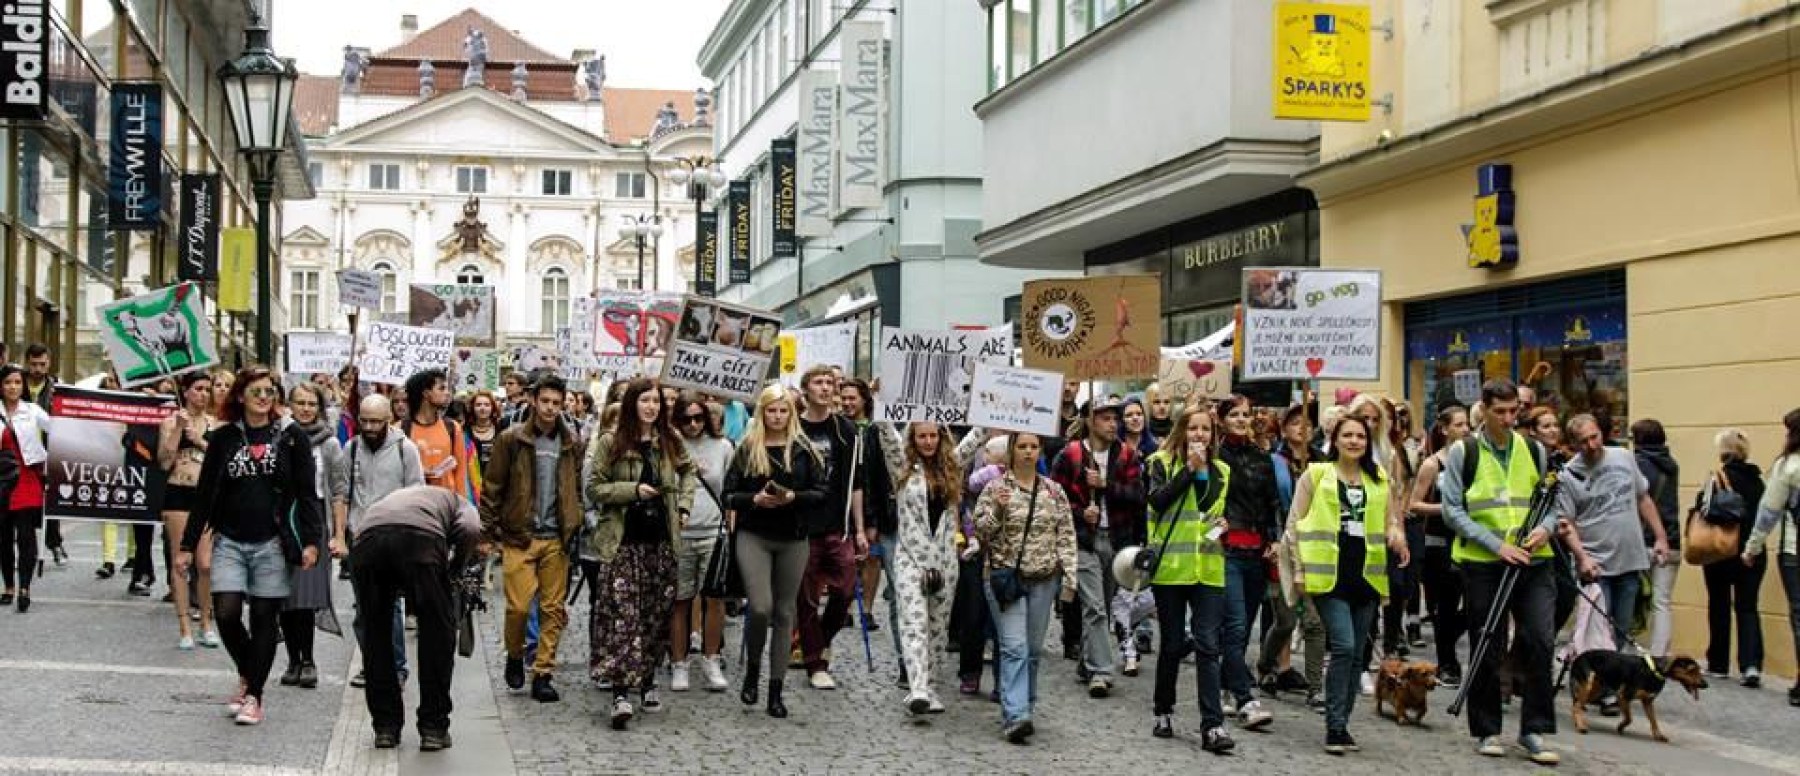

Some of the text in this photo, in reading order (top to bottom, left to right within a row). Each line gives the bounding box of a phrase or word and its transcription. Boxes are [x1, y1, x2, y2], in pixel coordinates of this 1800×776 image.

[2, 0, 42, 105] Baldi
[1282, 76, 1366, 100] SPARKYS
[846, 39, 880, 188] MaxMara
[125, 92, 147, 222] FREYWILLE
[802, 86, 833, 218] MaxMara
[781, 164, 794, 230] FRIDAY
[737, 201, 748, 260] FRIDAY
[1184, 222, 1285, 270] BURBERRY
[704, 231, 715, 282] FRIDAY
[1037, 287, 1096, 331] GOOD NIGHT
[1305, 291, 1325, 308] go
[677, 349, 712, 368] TAKY
[887, 333, 1006, 356] ANIMALS ARE
[884, 404, 967, 422] NOT PROD
[61, 460, 148, 487] VEGAN
